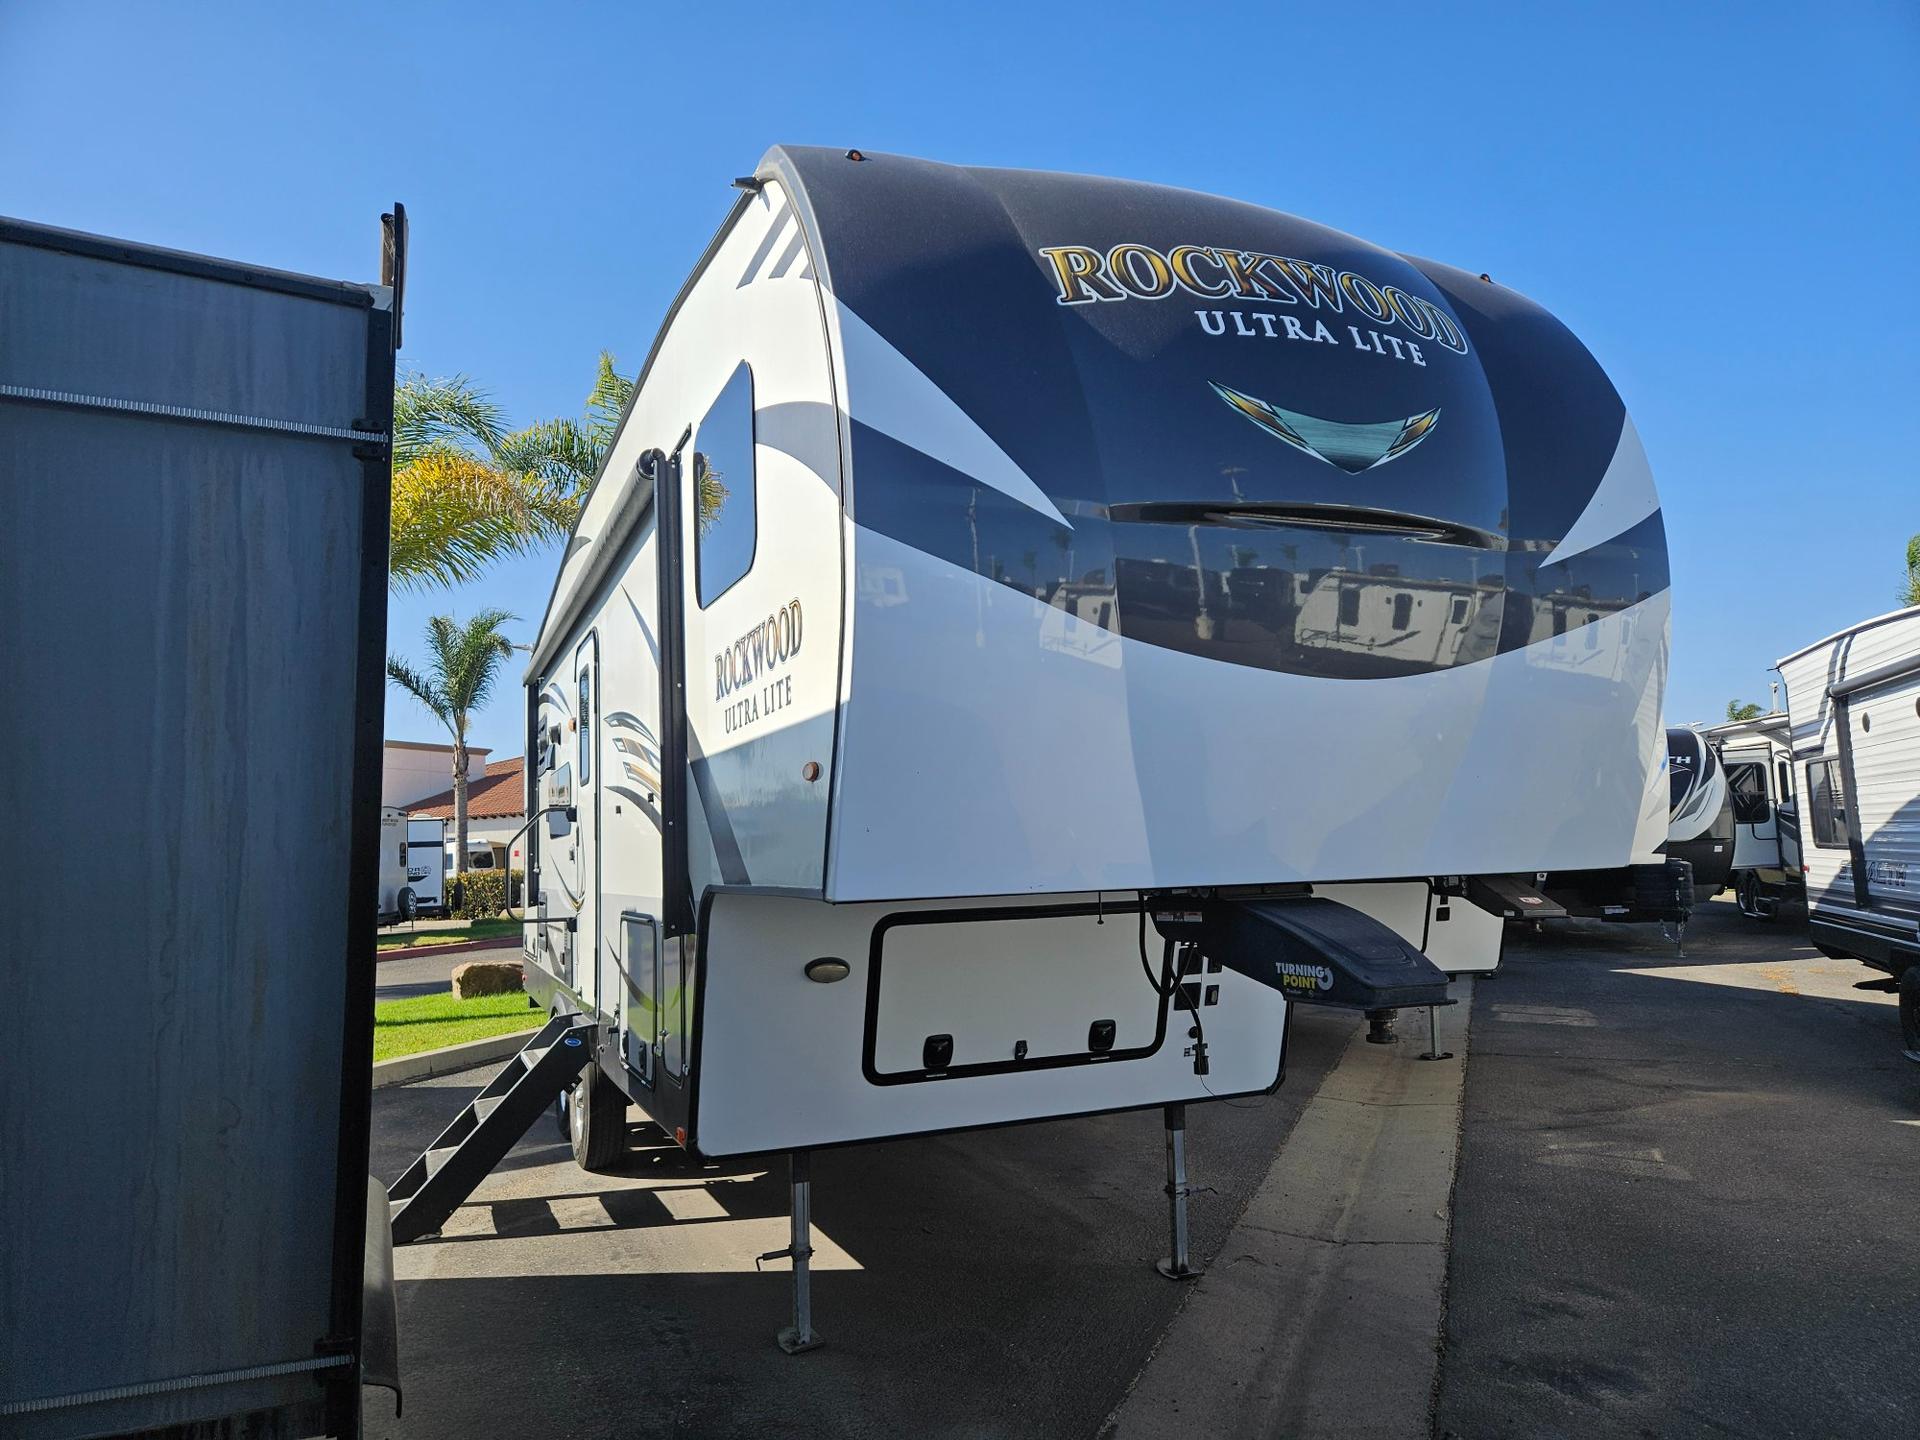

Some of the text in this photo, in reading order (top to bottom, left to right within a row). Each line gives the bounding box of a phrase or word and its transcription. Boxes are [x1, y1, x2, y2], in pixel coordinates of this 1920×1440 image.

[1039, 244, 1468, 356] ROCKWOOD
[1195, 310, 1427, 367] ULTRA LITE
[715, 597, 803, 702] ROCKWOOD
[724, 675, 792, 734] ULTRA LITE
[1275, 962, 1325, 978] TURNING
[1283, 974, 1316, 989] POINT
